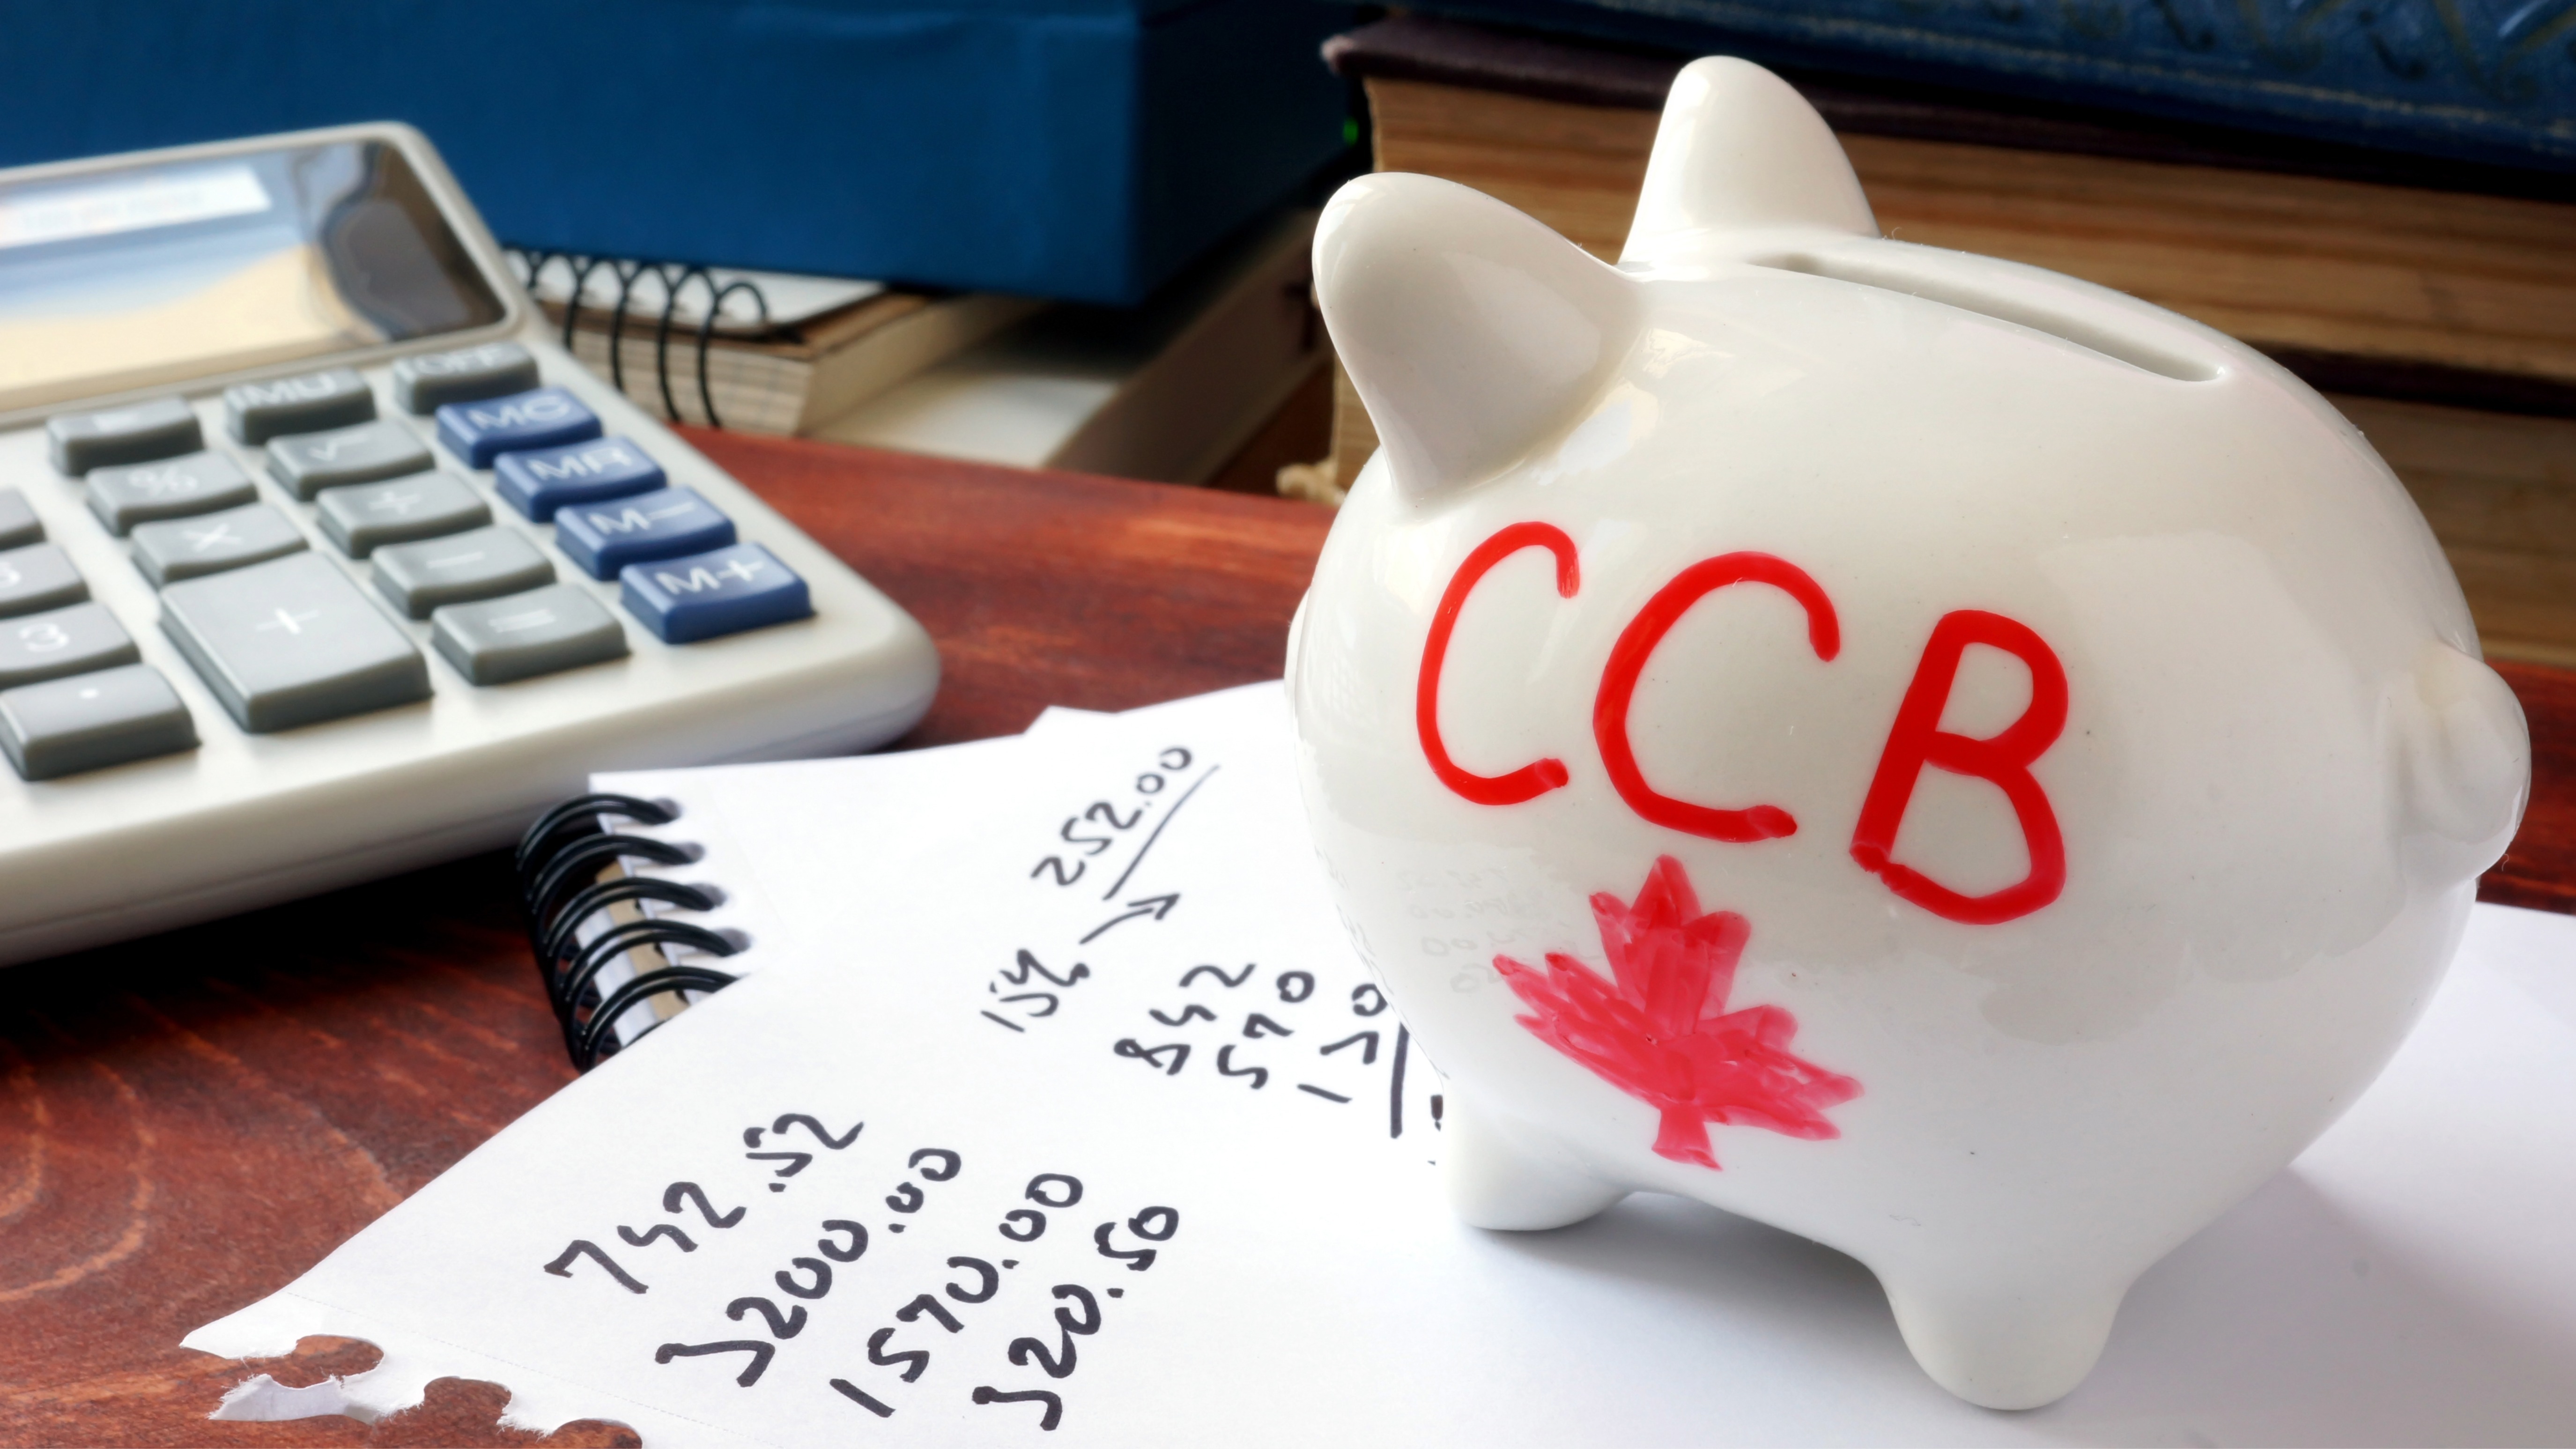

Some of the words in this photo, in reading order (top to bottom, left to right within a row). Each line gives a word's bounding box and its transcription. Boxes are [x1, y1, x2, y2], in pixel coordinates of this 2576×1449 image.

[468, 396, 570, 429] MC
[528, 447, 632, 479] MR
[656, 560, 764, 594] M+
[19, 623, 69, 652] 3
[1416, 521, 2069, 925] CCB
[1032, 747, 1192, 886] 252.00
[1216, 970, 1315, 1090] 570
[544, 1113, 863, 1294] 742.52
[829, 1173, 1083, 1418] 1570.00
